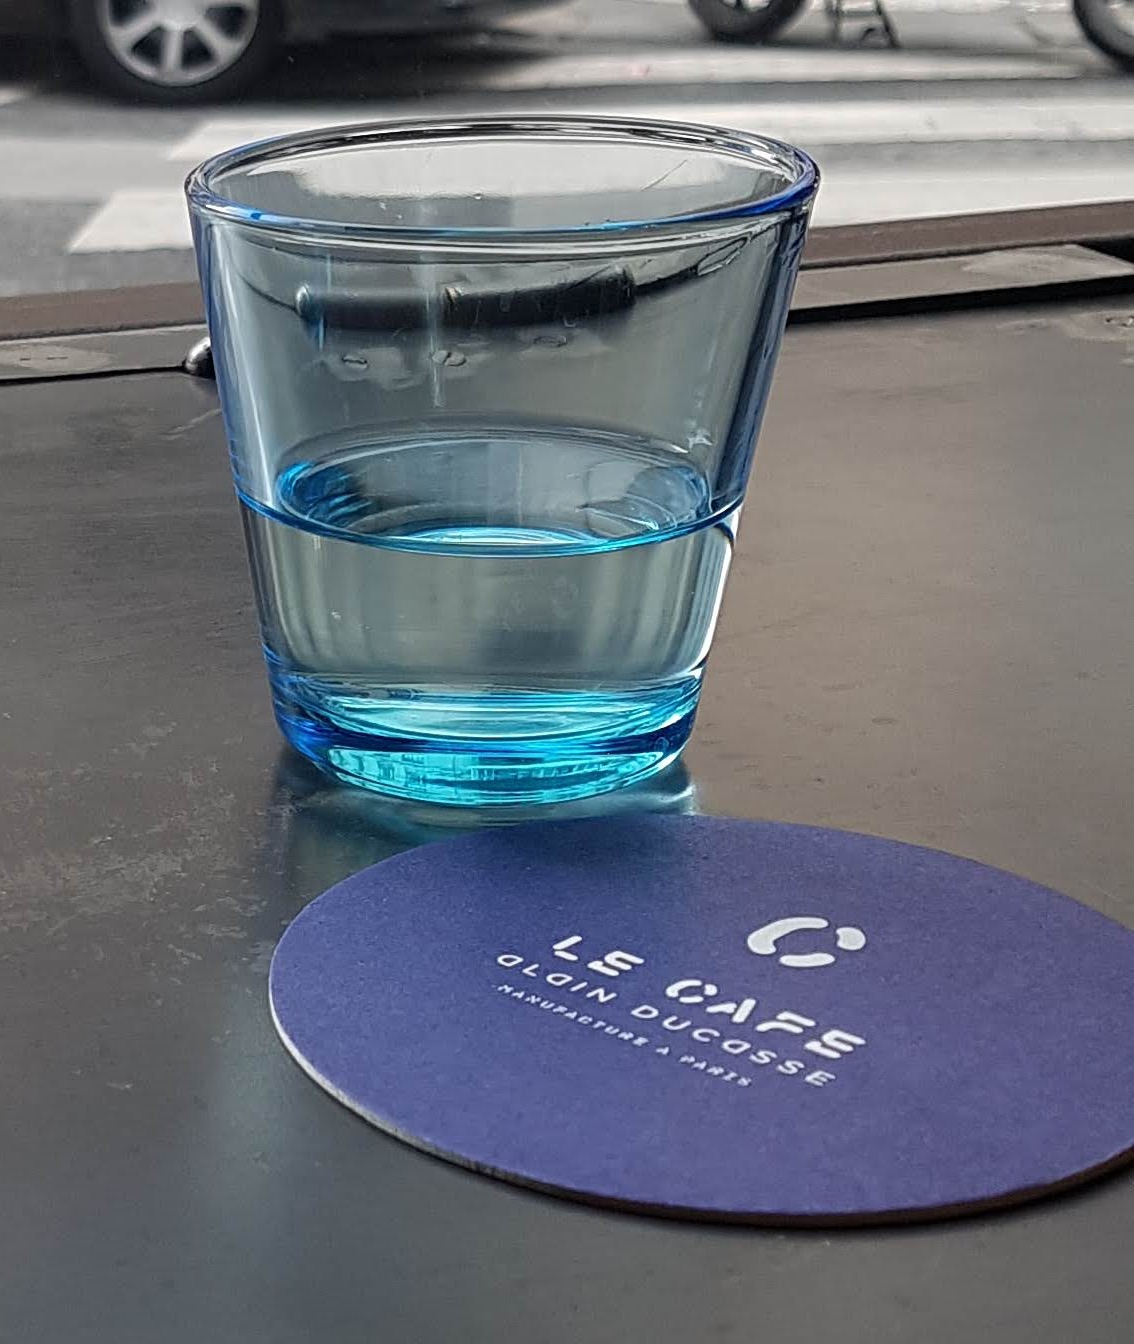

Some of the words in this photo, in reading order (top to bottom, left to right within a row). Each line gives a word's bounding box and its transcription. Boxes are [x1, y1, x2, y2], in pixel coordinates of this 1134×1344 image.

[496, 984, 650, 1047] MANUFACTURE
[679, 1056, 755, 1088] PARIS
[553, 935, 645, 977] LE
[665, 979, 866, 1059] CAFE
